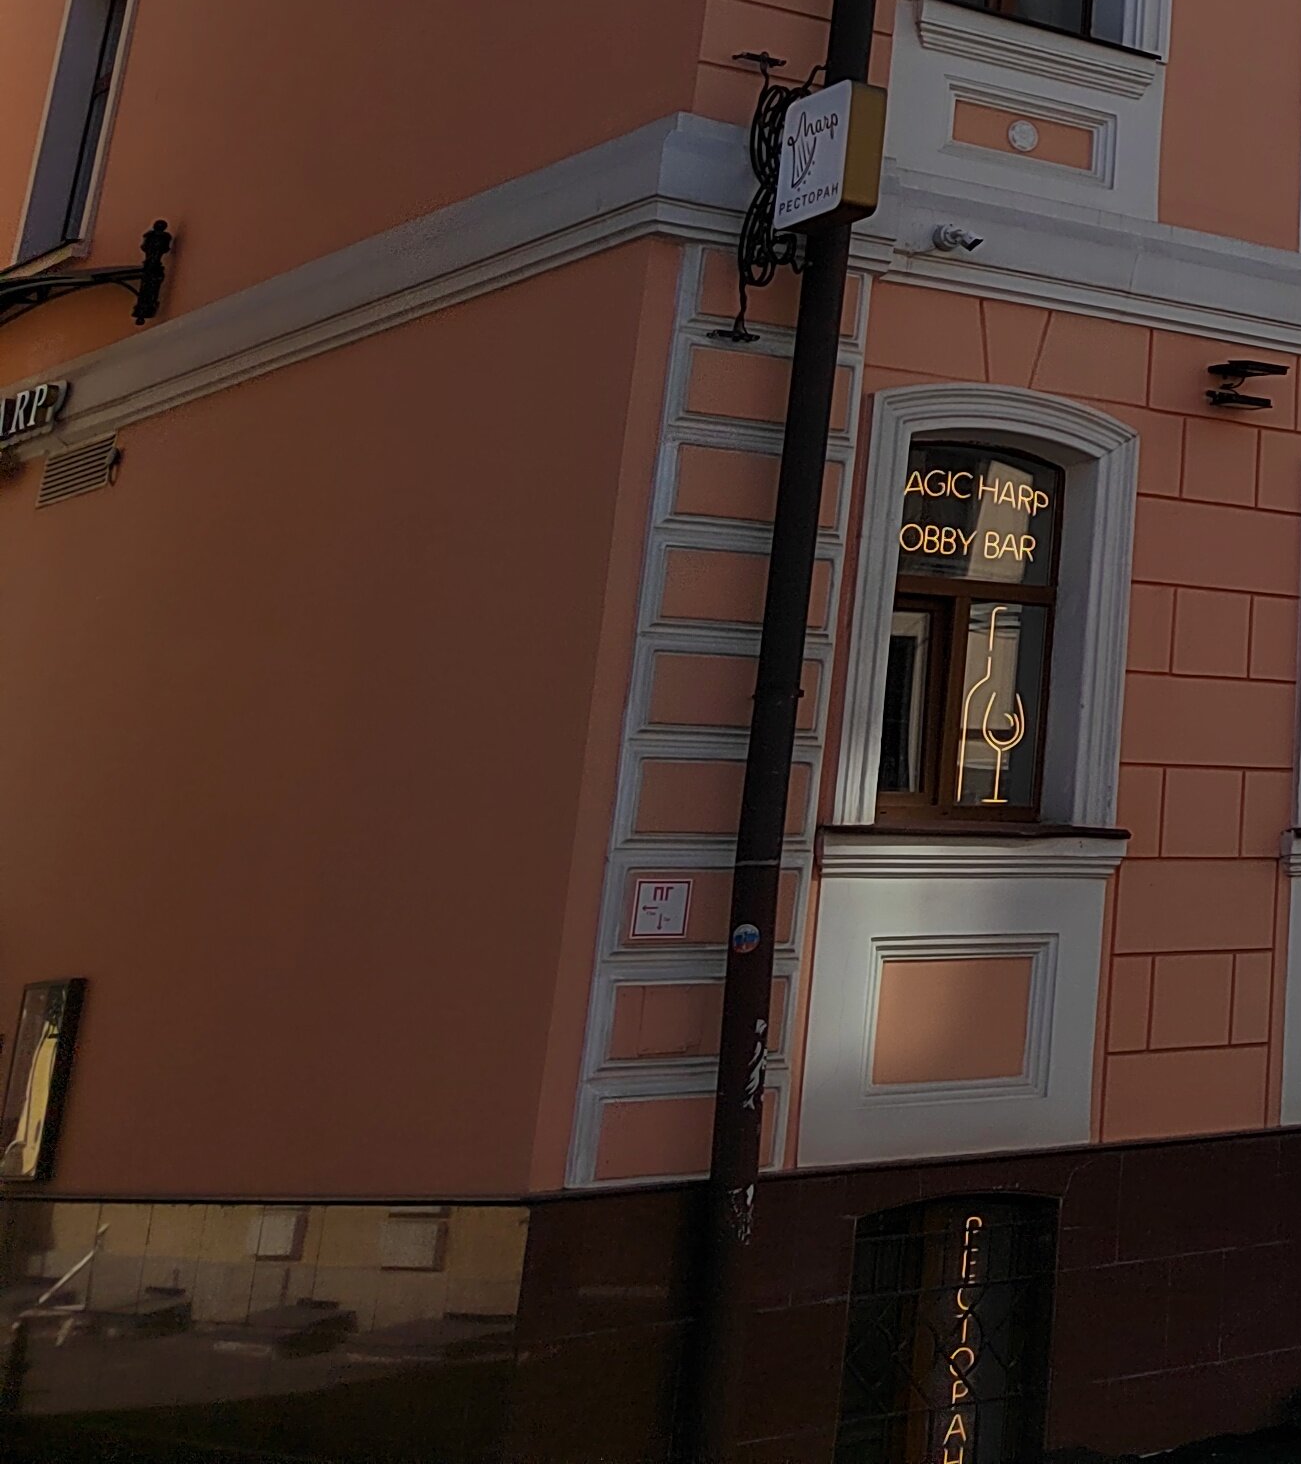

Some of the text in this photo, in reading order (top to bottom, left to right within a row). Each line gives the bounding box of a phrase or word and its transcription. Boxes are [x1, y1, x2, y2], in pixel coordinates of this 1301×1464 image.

[778, 182, 840, 216] РЕСТОРАН
[977, 474, 1050, 517] HARP
[899, 523, 1037, 563] OBBY BAR
[653, 886, 675, 901] ПГ
